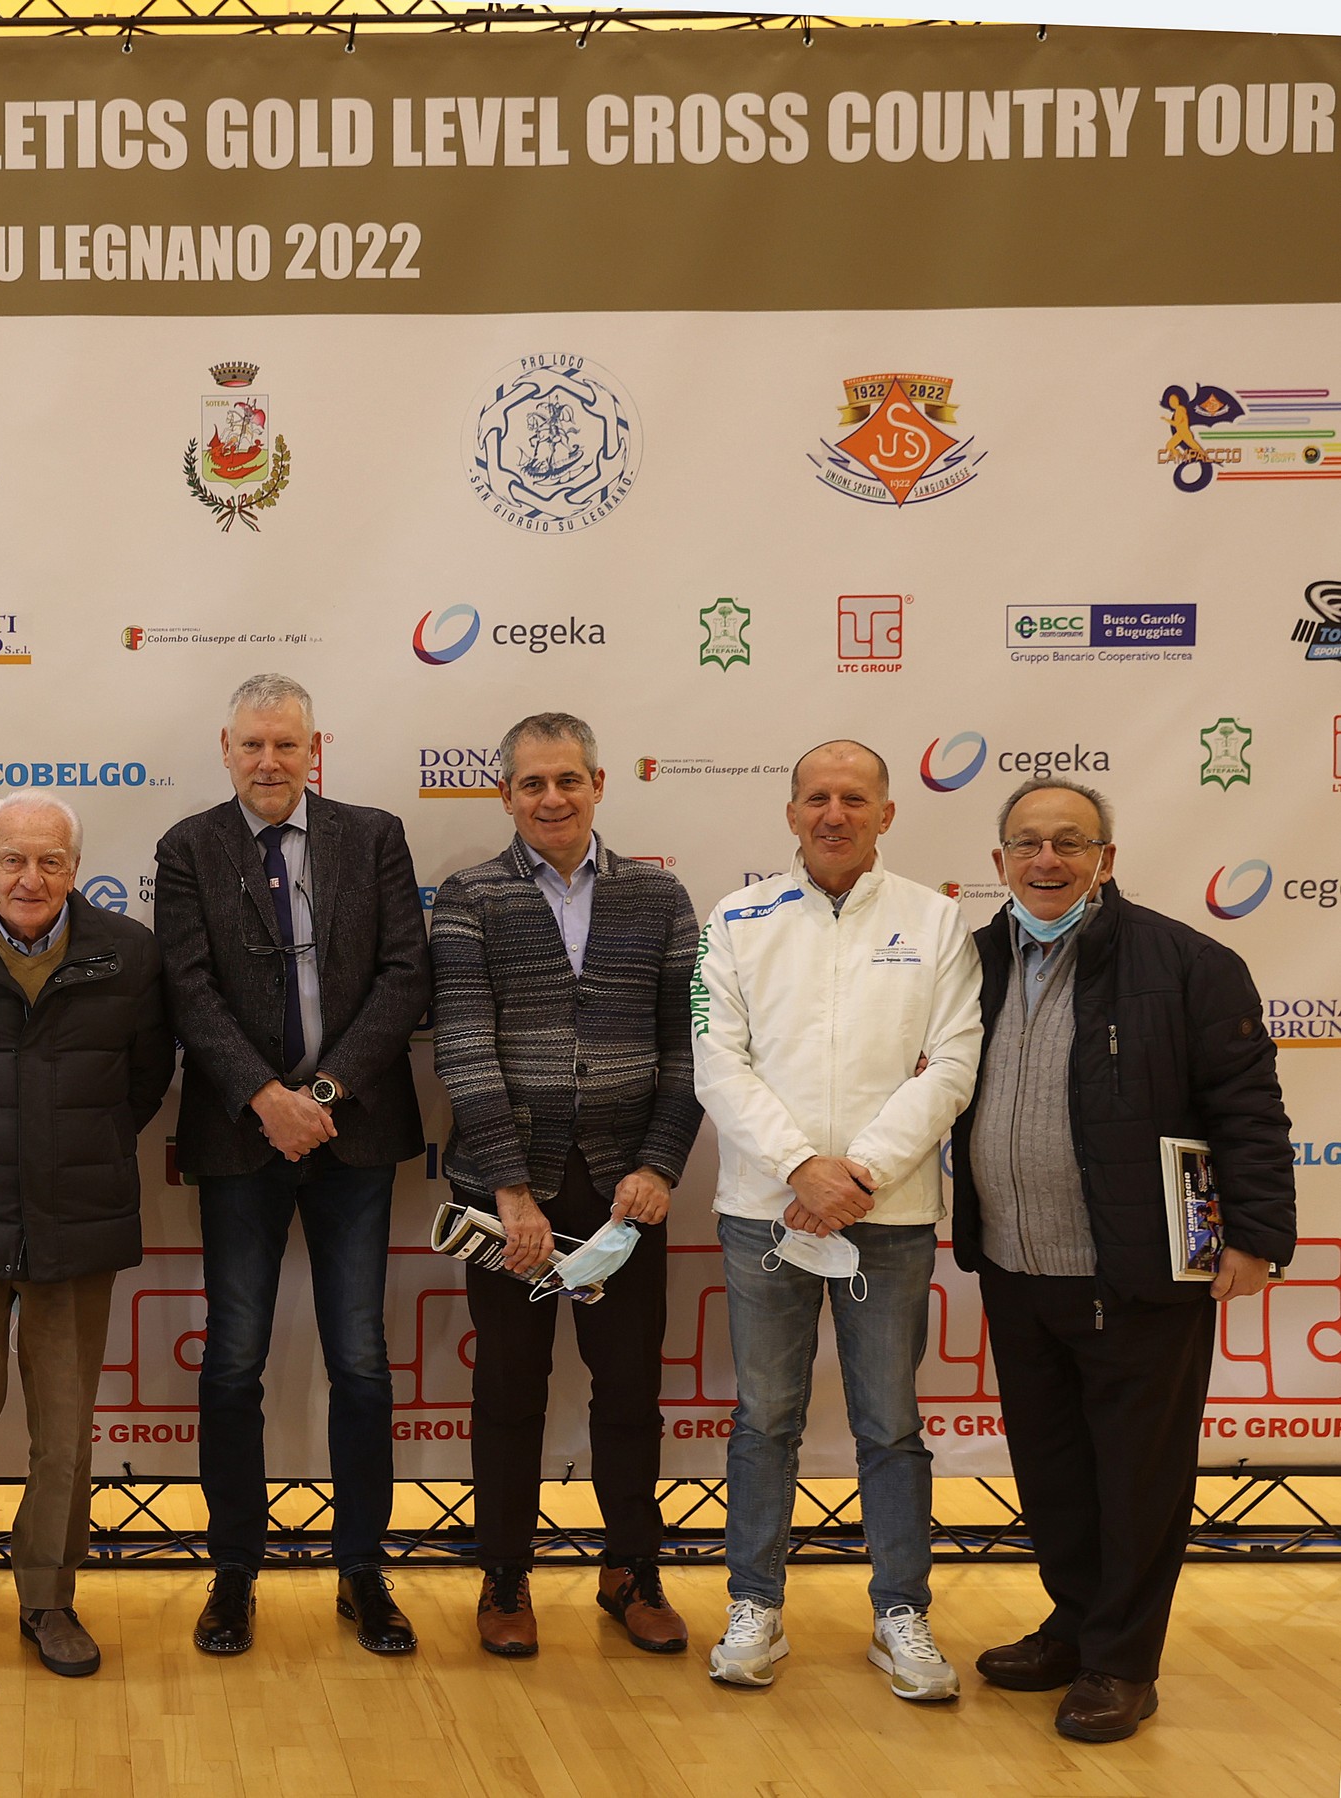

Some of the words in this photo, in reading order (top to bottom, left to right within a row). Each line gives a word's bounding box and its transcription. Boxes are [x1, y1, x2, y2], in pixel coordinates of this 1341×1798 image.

[205, 97, 374, 170] GOLD
[392, 96, 569, 169] LEVEL
[585, 92, 809, 167] CROSS
[826, 86, 1140, 165] COUNTRY
[1156, 81, 1336, 158] TOUR
[39, 222, 272, 283] LEGNANO
[285, 221, 421, 281] 2022
[520, 354, 545, 370] PRO
[553, 354, 584, 369] LOCO
[852, 384, 885, 400] 1922
[909, 384, 945, 400] 2022
[1157, 448, 1242, 465] CAMPACCIO
[825, 469, 852, 489] UNIONE
[853, 482, 887, 498] SPORTIVA
[914, 467, 971, 498] SANGIORGESE
[890, 479, 910, 490] 1922
[470, 475, 492, 501] SAN
[493, 503, 549, 532] GIORGIO
[558, 521, 574, 532] SU
[582, 477, 632, 526] LEGNANO
[1039, 617, 1084, 631] BCC
[1103, 614, 1137, 625] Busto
[1140, 613, 1186, 625] Garolfo
[148, 635, 189, 643] Colombo
[191, 635, 235, 645] Giuseppe
[238, 634, 247, 643] di
[249, 634, 276, 643] Carlo
[285, 634, 307, 644] Figli
[492, 616, 606, 654] cegeka
[1105, 629, 1112, 637] e
[1115, 626, 1183, 640] Buguggiate
[1320, 628, 1341, 642] TO
[5, 645, 31, 655] S.r.l.
[1011, 652, 1049, 664] Gruppo
[1053, 651, 1095, 662] Bancario
[1098, 651, 1160, 663] Cooperativo
[1163, 651, 1193, 661] Iccrea
[837, 664, 858, 673] LTC
[861, 664, 902, 673] GROUP
[998, 743, 1110, 779] cegeka
[661, 766, 701, 774] Colombo
[705, 766, 748, 776] Giuseppe
[751, 765, 760, 773] di
[763, 765, 789, 773] Carlo
[149, 776, 175, 787] s.r.l.
[963, 890, 1004, 898] Colombo
[108, 1422, 200, 1443] GROU
